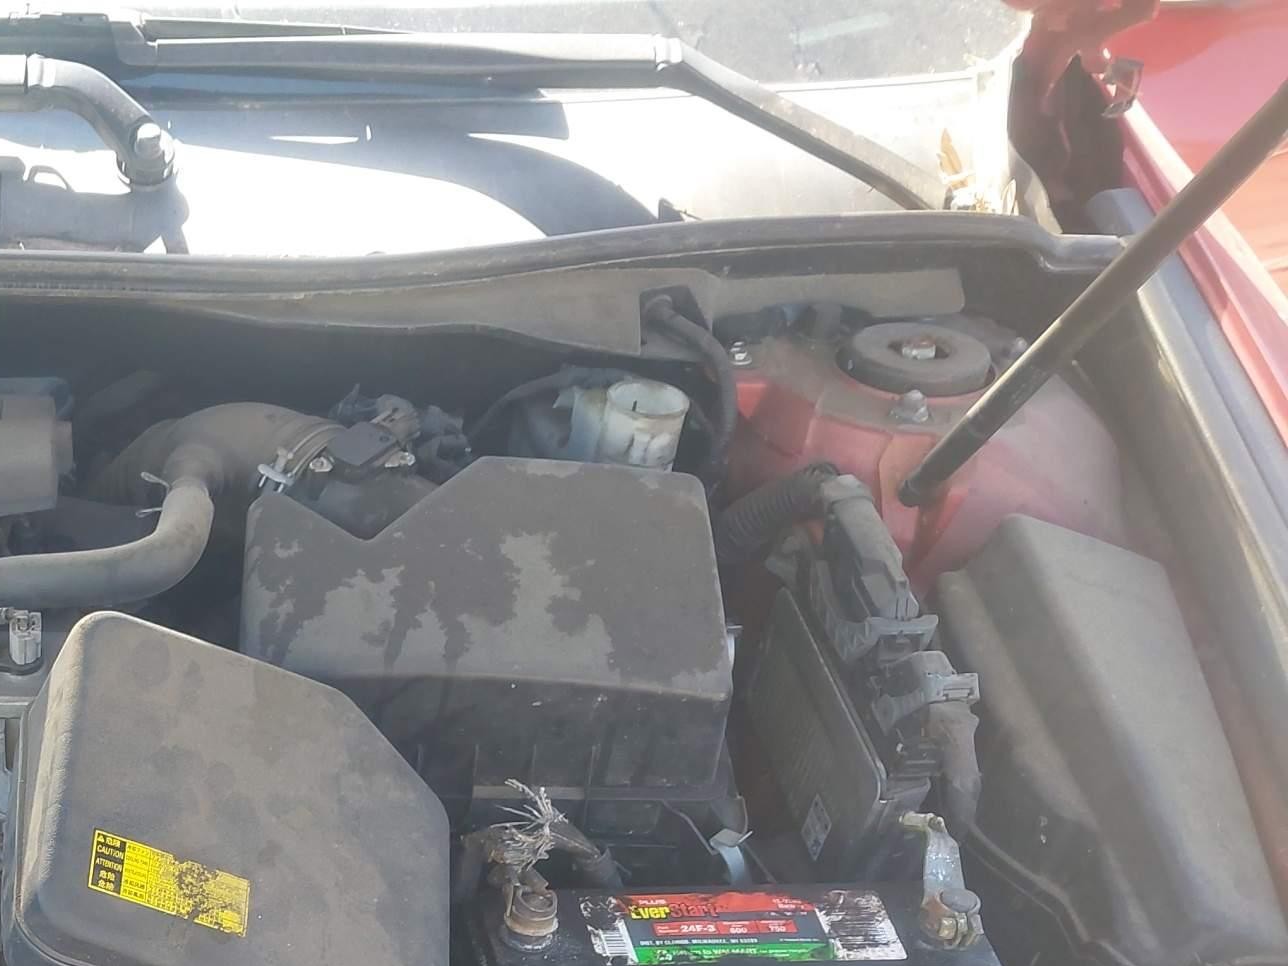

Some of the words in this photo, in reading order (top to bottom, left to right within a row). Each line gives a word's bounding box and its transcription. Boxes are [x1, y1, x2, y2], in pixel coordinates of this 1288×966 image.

[97, 845, 124, 860] CAUTION
[95, 858, 122, 872] ATTENTION
[631, 903, 719, 920] EverStart
[680, 924, 716, 934] 24F-3
